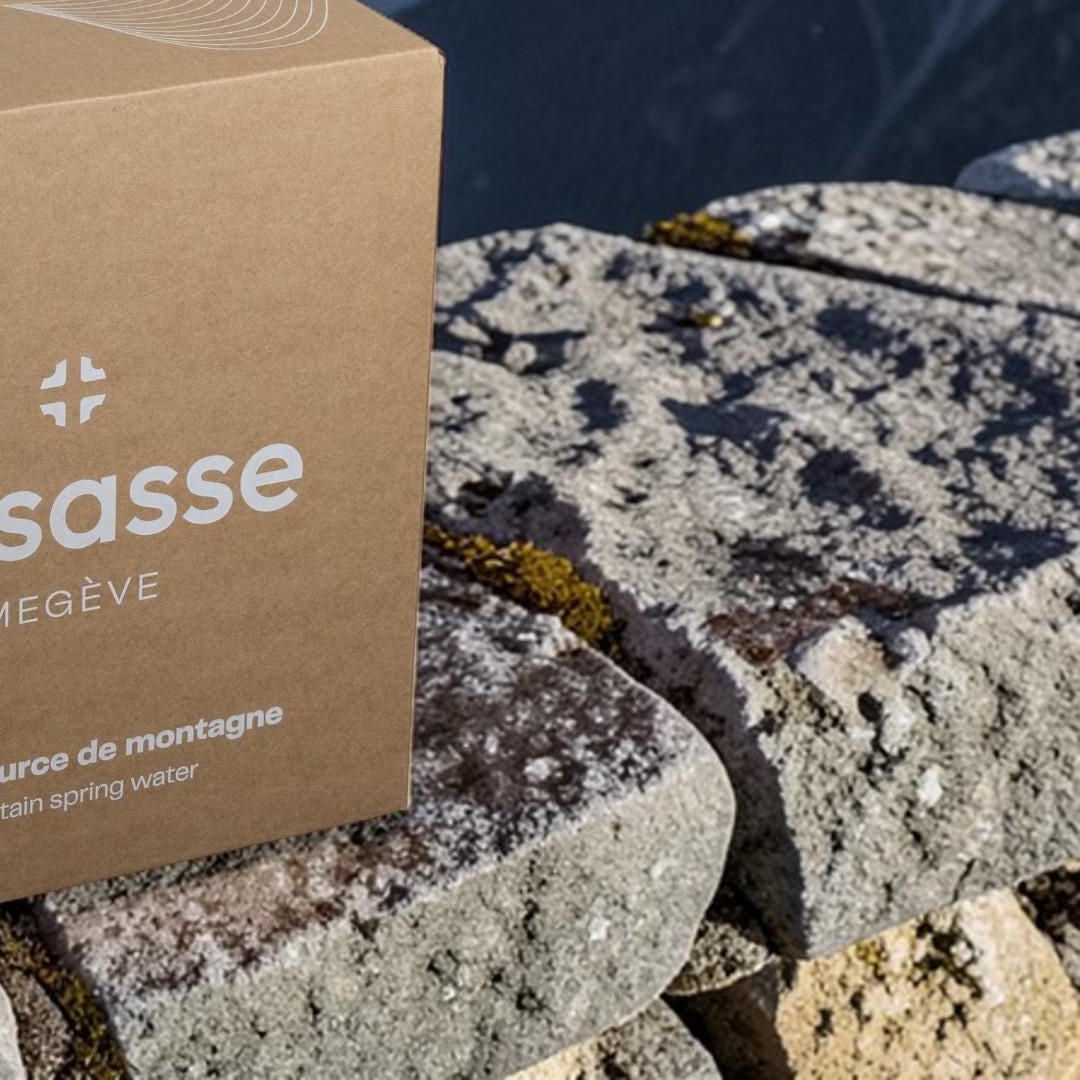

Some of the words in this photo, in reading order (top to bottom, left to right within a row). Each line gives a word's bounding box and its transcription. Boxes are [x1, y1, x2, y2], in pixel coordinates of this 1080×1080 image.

[77, 739, 117, 766] de
[125, 704, 284, 756] montagne
[49, 777, 124, 813] spring
[131, 762, 199, 792] water
